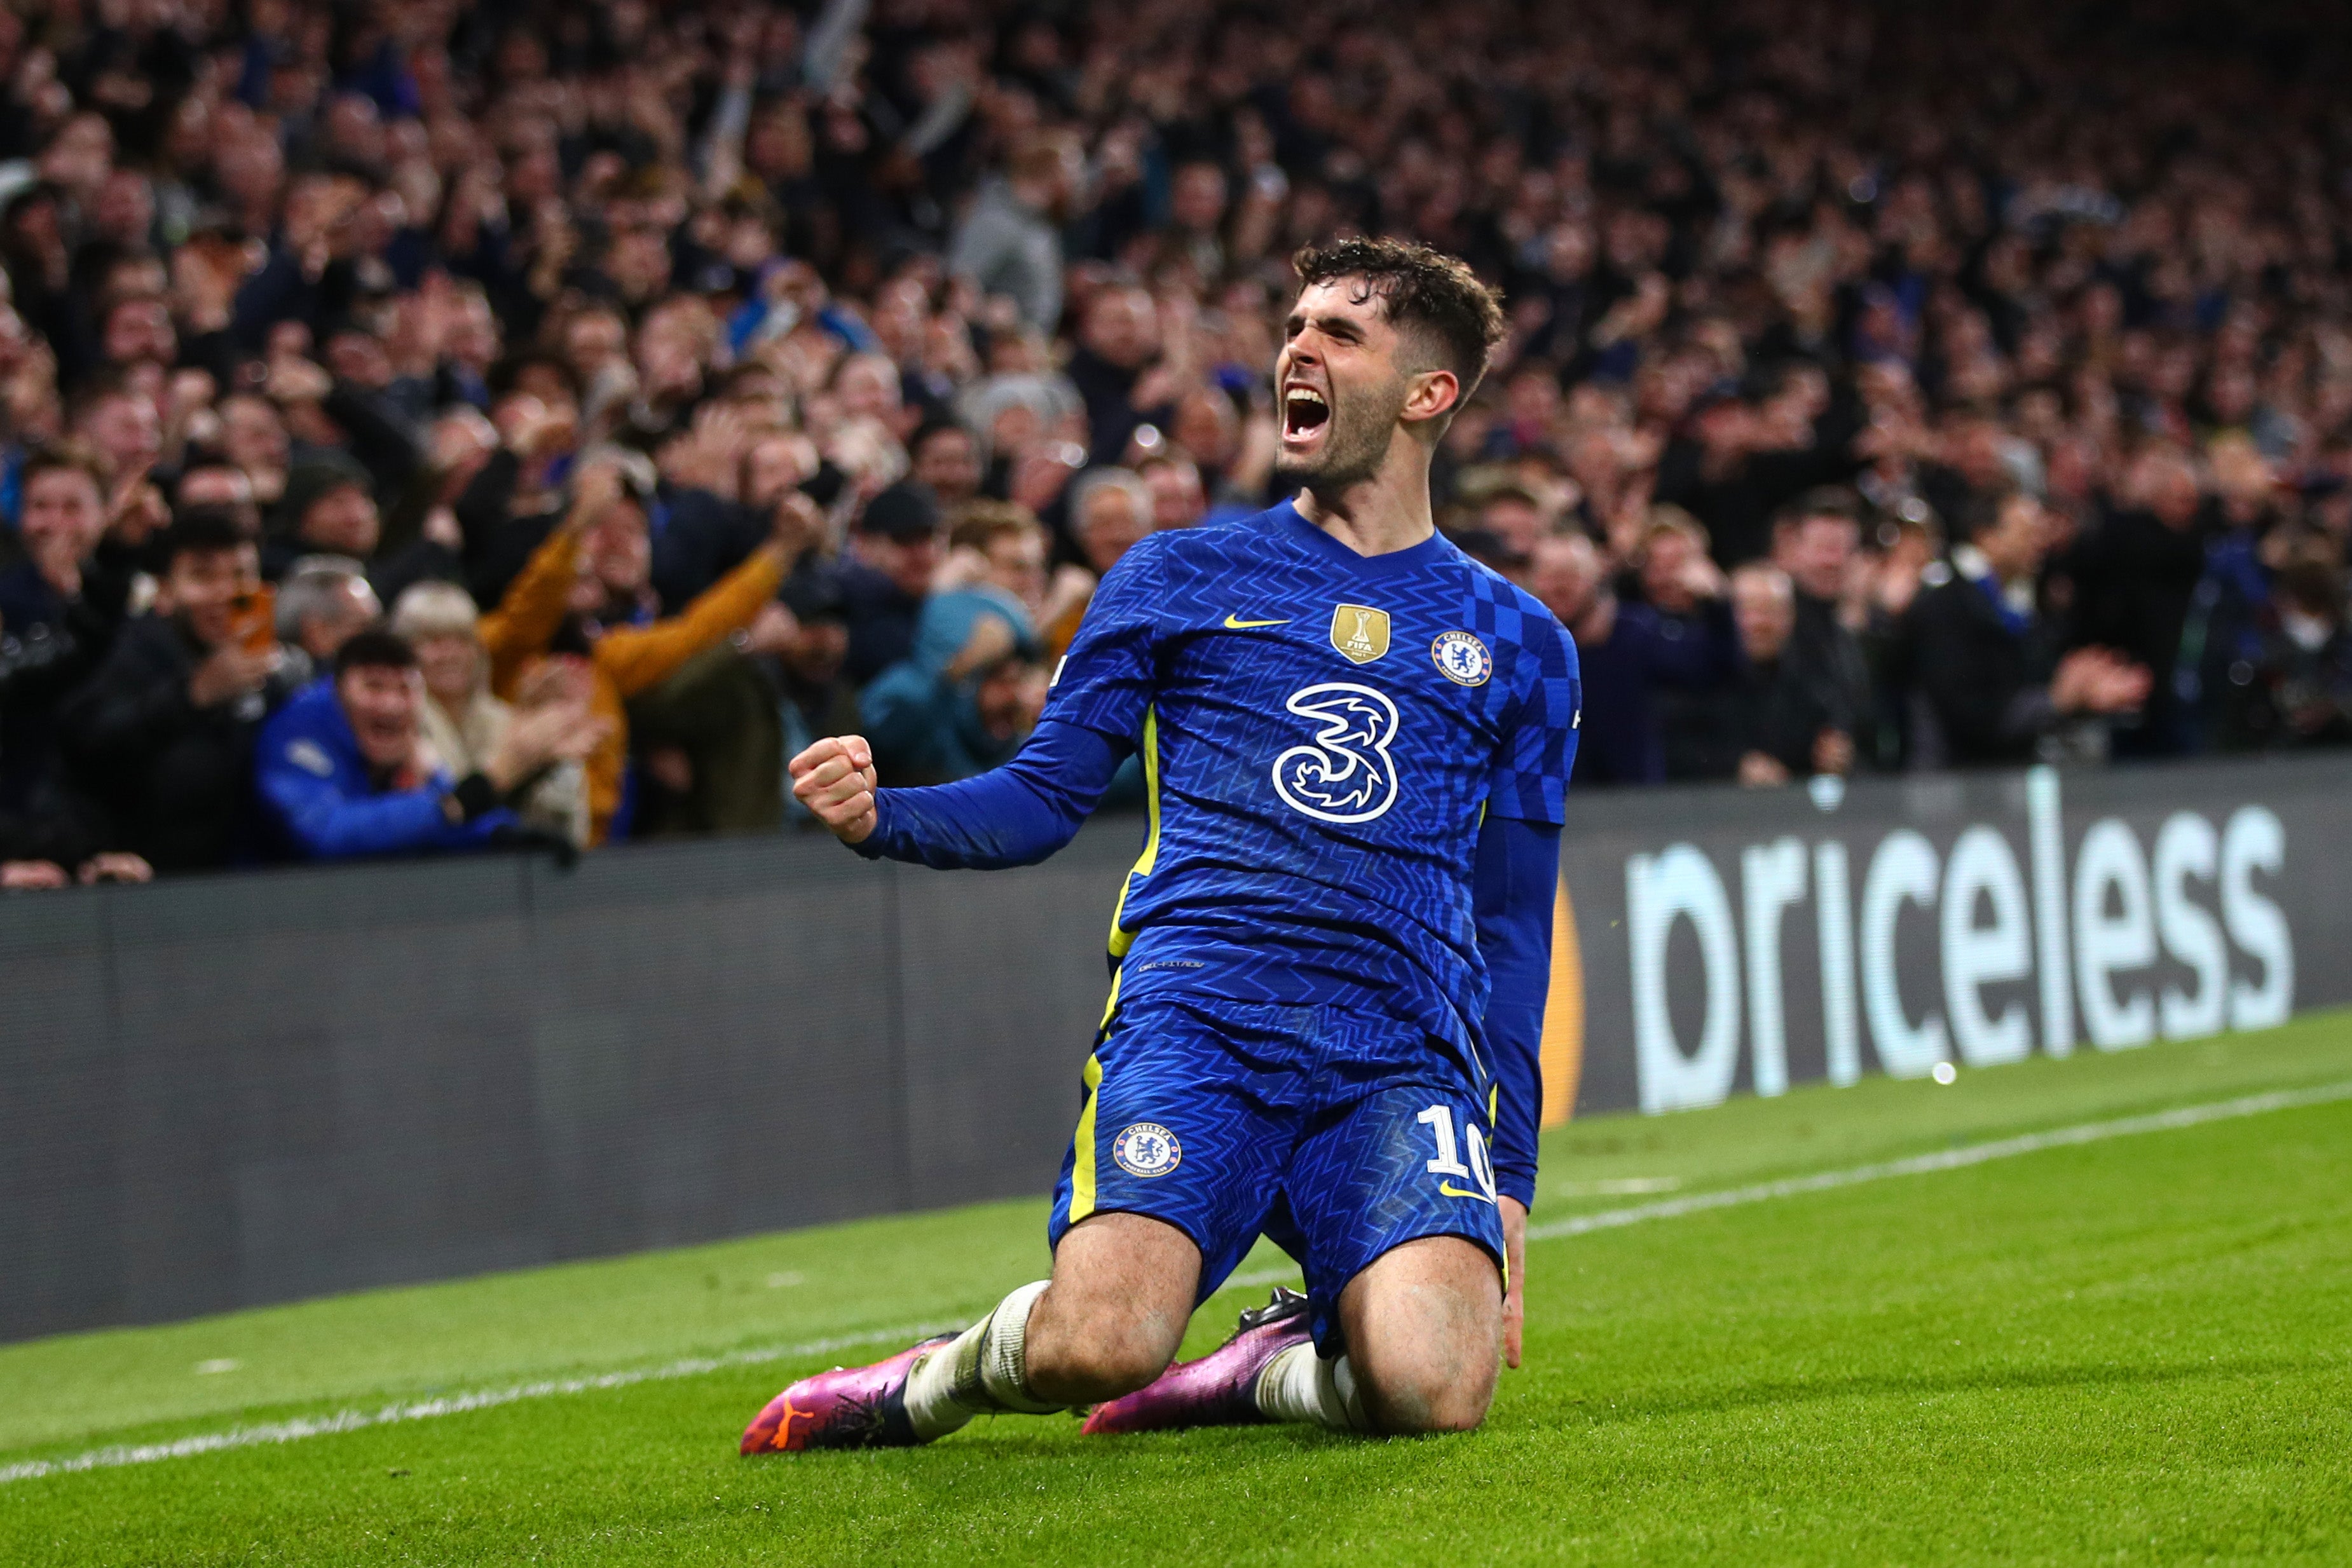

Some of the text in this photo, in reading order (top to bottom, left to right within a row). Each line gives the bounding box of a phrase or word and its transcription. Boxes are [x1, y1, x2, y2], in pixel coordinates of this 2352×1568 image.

[1347, 640, 1372, 651] FIFA
[1444, 634, 1482, 651] CHELSEA
[1272, 682, 1399, 823] 3
[1625, 763, 2295, 1115] priceless
[1128, 1125, 1171, 1141] CHELSEA
[1417, 1105, 1497, 1203] 10
[1123, 1162, 1151, 1174] FOOTBALL
